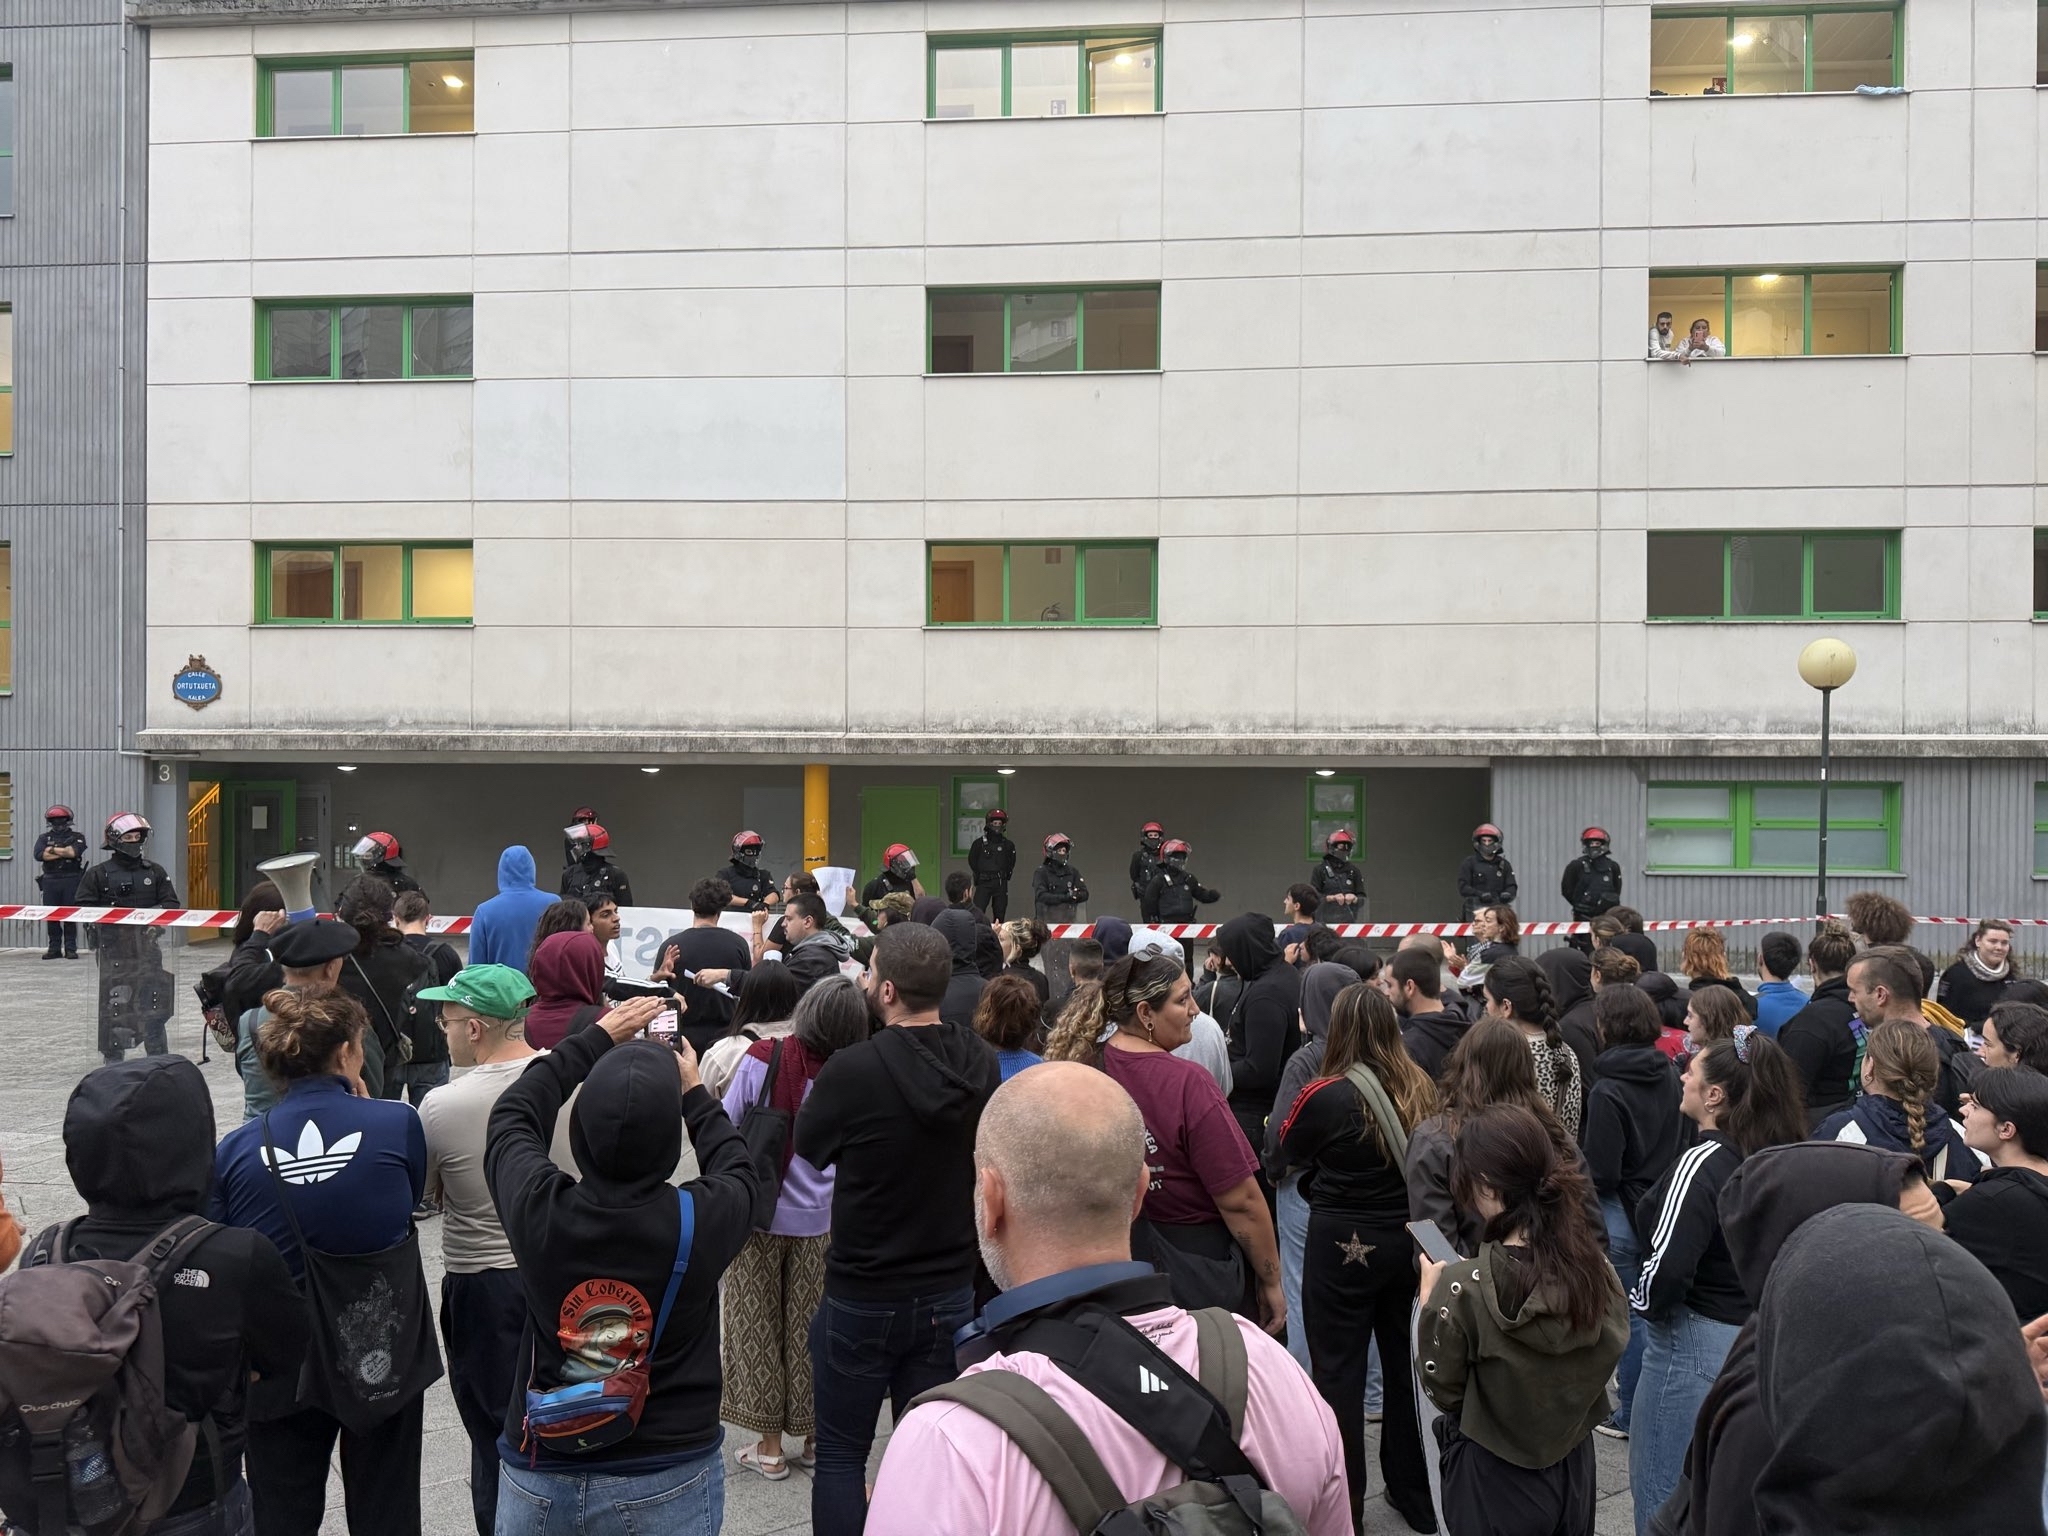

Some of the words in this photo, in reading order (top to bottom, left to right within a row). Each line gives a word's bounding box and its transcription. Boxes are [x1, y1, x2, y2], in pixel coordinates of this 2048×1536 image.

[159, 764, 170, 781] 3
[174, 1279, 196, 1287] FACE
[562, 1294, 584, 1319] Sin
[585, 1281, 647, 1322] Cobertura
